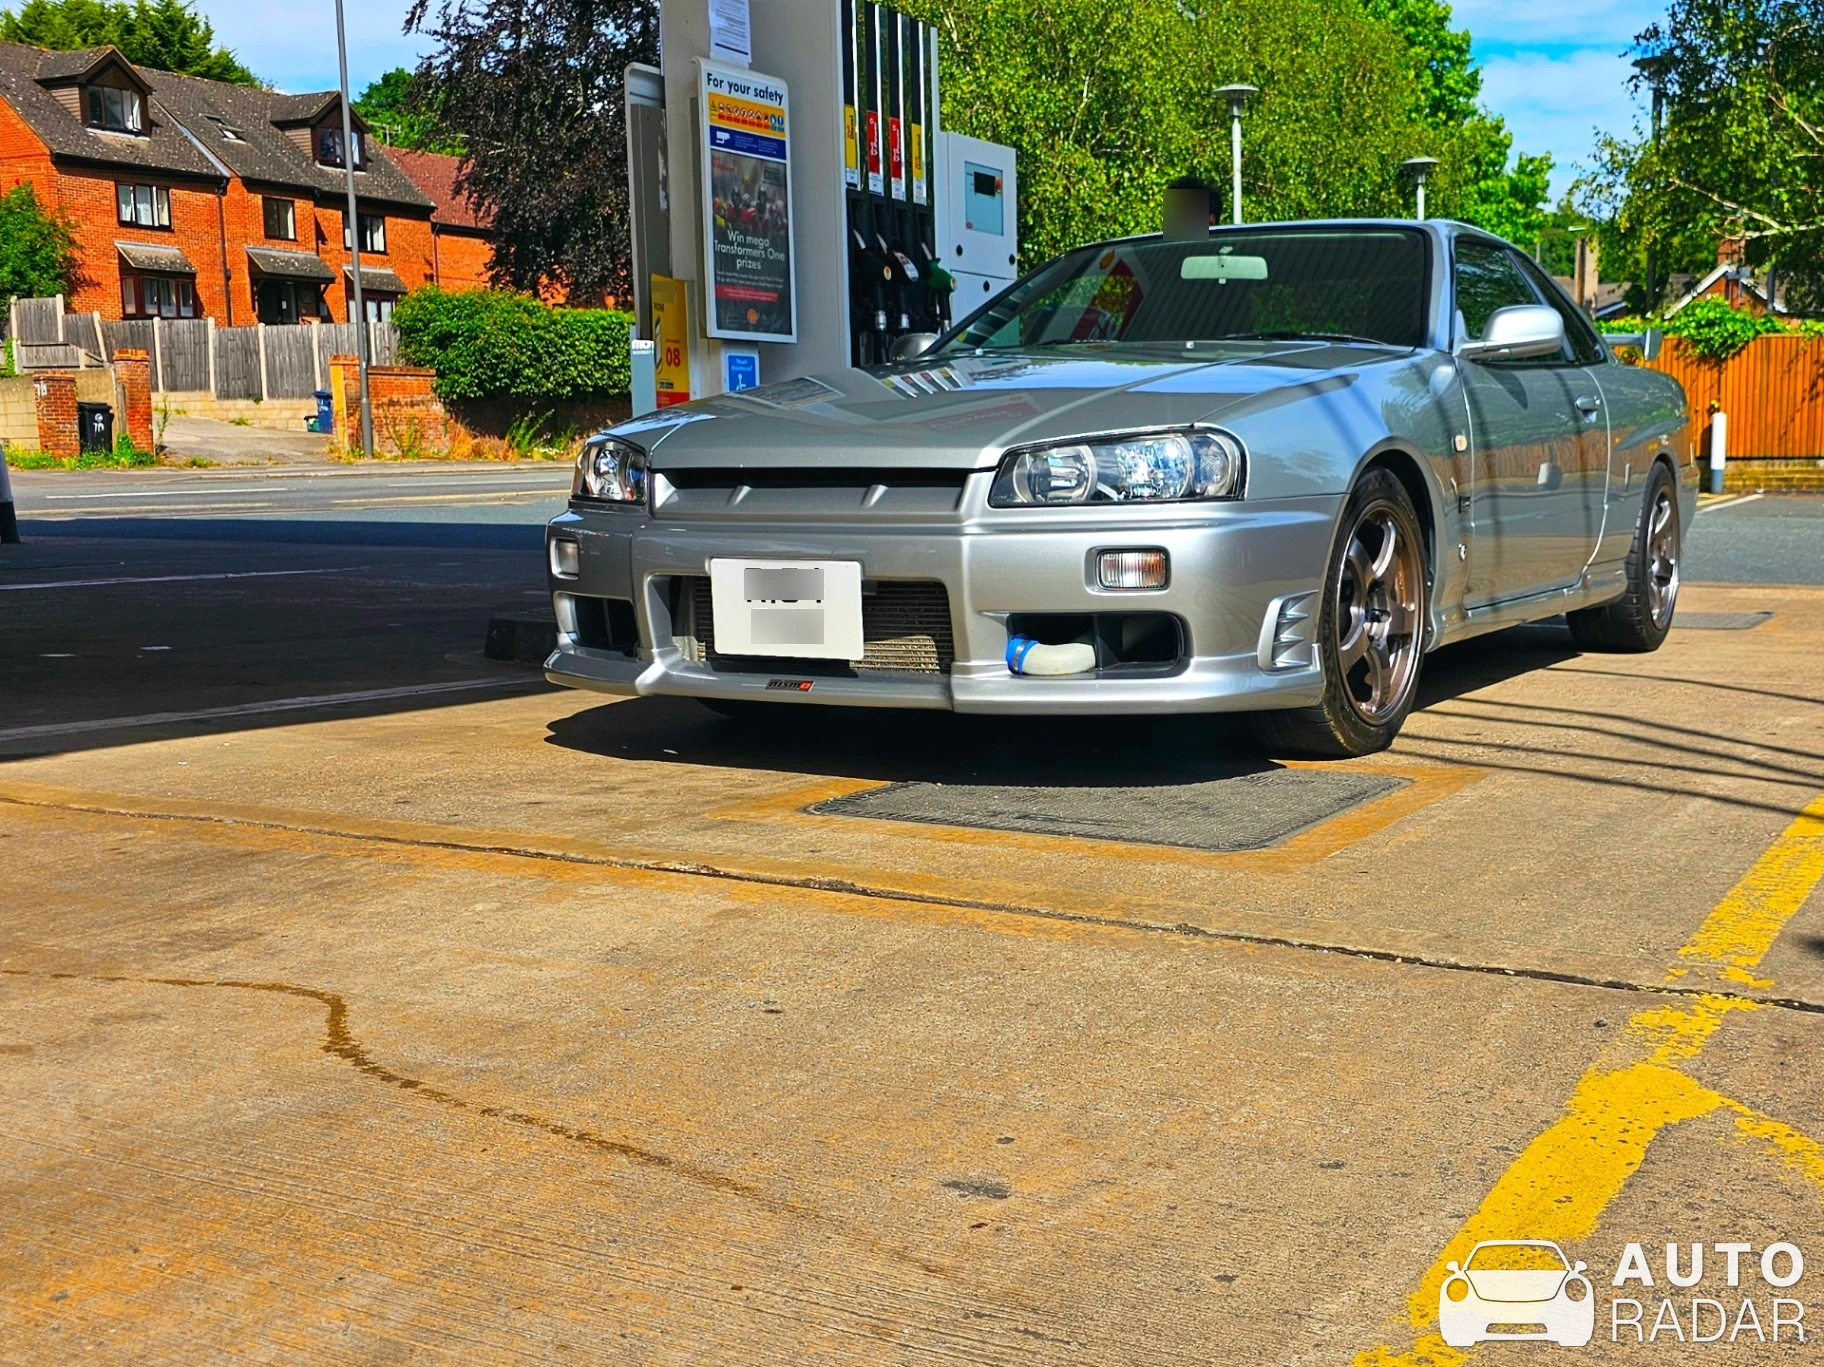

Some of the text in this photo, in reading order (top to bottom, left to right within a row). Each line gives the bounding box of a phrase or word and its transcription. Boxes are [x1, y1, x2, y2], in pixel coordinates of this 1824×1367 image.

[707, 72, 784, 106] For your safety
[727, 229, 770, 249] Win mega
[714, 240, 786, 261] Transformers One
[736, 256, 762, 270] prizes
[666, 347, 681, 367] 08
